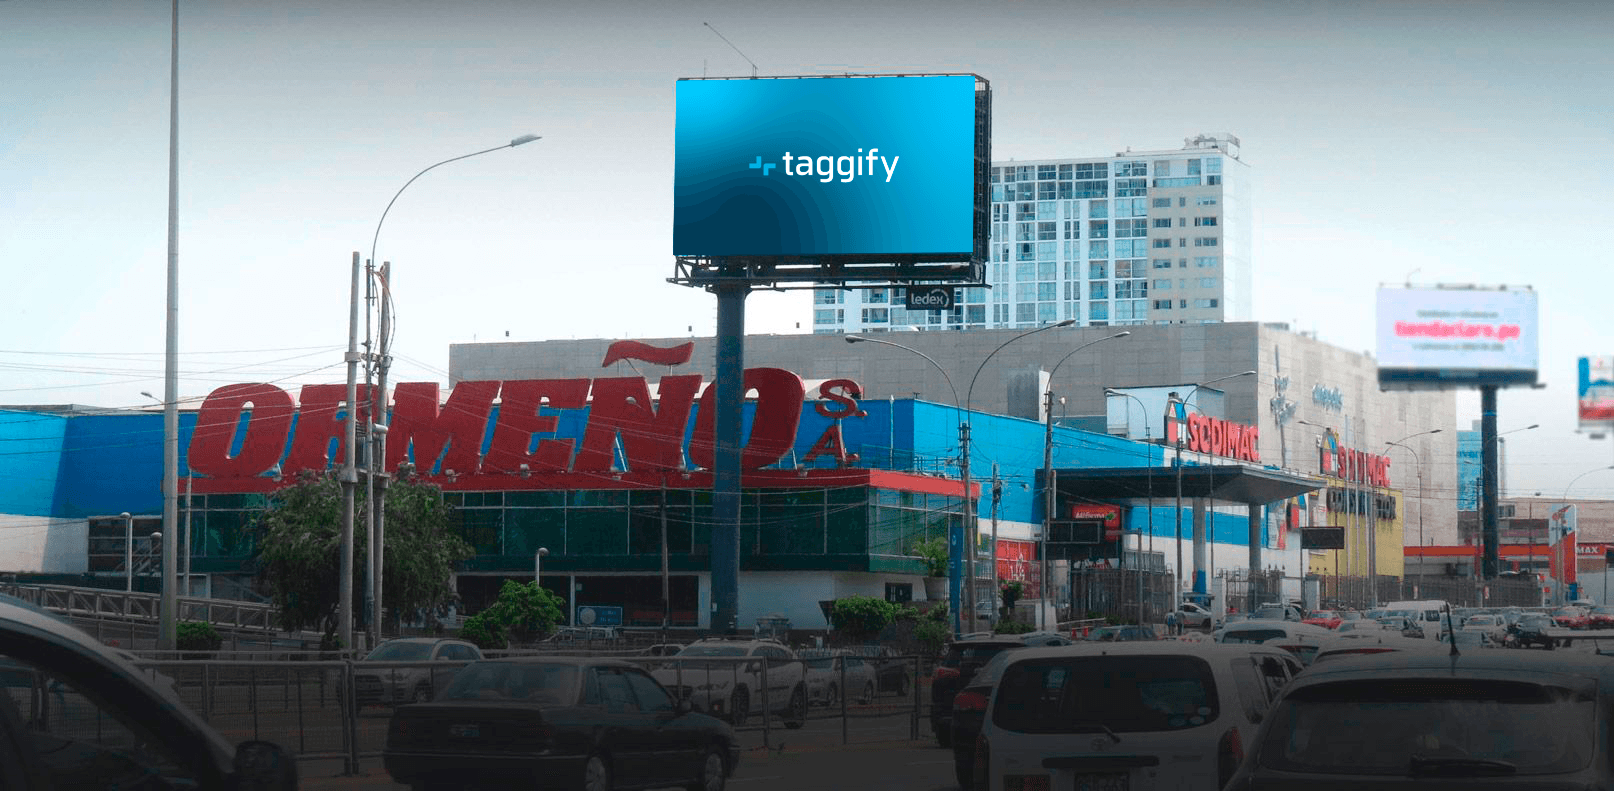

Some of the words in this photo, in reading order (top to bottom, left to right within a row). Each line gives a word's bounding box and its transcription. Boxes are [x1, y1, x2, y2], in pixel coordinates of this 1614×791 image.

[782, 148, 900, 183] taggify
[911, 292, 943, 305] ledex
[187, 340, 806, 471] ORMEÑO
[1187, 411, 1260, 463] SODIMAC
[1337, 445, 1391, 488] SODIMAC
